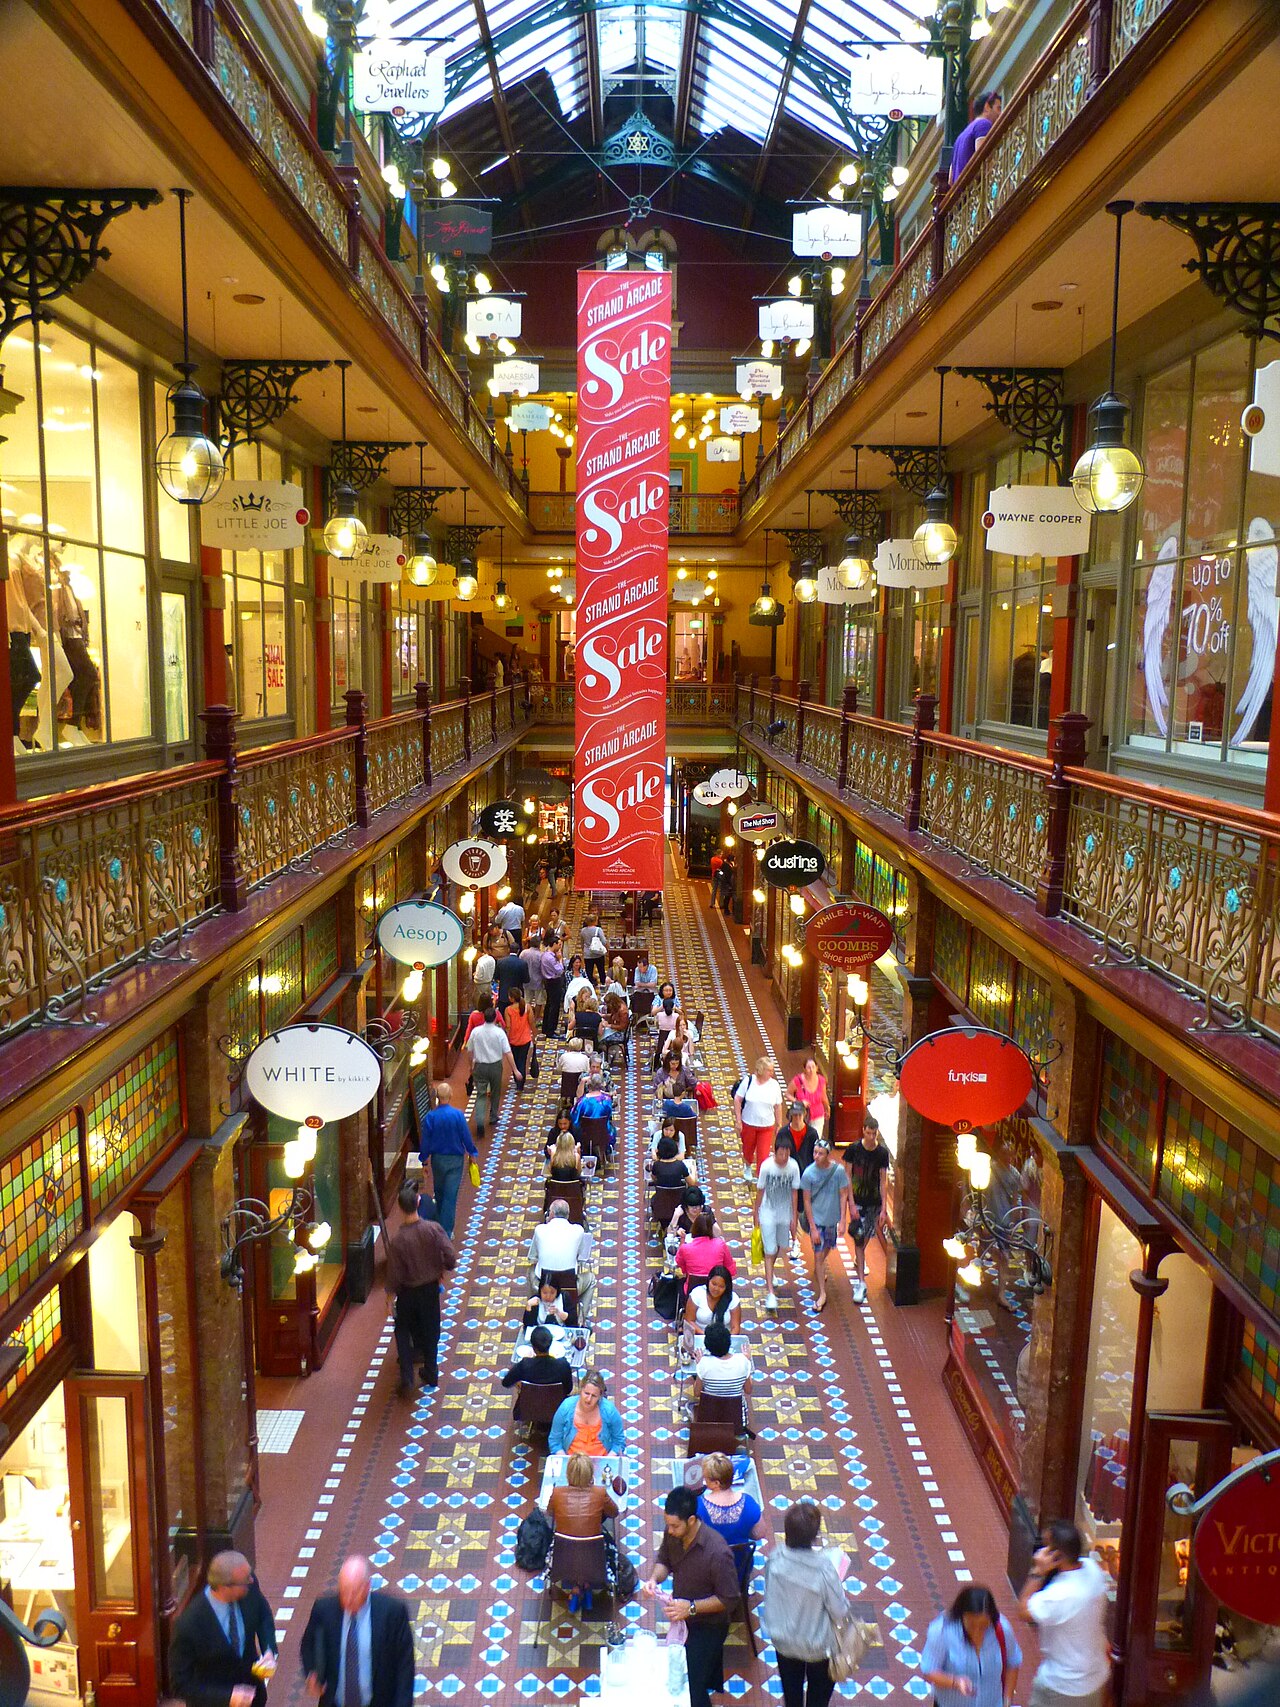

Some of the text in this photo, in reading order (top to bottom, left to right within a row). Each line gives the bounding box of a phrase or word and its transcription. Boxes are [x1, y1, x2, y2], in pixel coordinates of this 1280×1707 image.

[369, 59, 427, 85] Raphael
[365, 82, 430, 104] Jewellers
[620, 281, 630, 291] THE
[587, 276, 663, 327] STRAND ARCADE
[580, 330, 667, 410] Sale
[1249, 415, 1261, 428] 69
[618, 432, 628, 443] THE
[586, 428, 661, 477] STRAND ARCADE
[217, 517, 288, 530] LITTLE JOE
[579, 479, 665, 558] Sale
[998, 513, 1082, 524] WAYNE COOPER
[341, 559, 370, 567] LITTLE
[373, 559, 391, 568] JOE
[1192, 557, 1231, 592] up to
[617, 579, 627, 590] THE
[585, 592, 621, 624] STRAND
[623, 575, 659, 606] ARCADE
[1210, 620, 1230, 654] off
[578, 626, 663, 703] Sale
[267, 667, 284, 688] SALE
[616, 723, 626, 733] THE
[584, 719, 658, 767] STRAND ARCADE
[714, 778, 743, 789] seed
[577, 769, 661, 844] Sale
[743, 820, 753, 828] The
[753, 819, 762, 827] Nut
[768, 855, 818, 869] dustins
[817, 940, 879, 952] COOMBS
[822, 951, 874, 964] SHOE REPAIRS
[262, 1066, 335, 1082] WHITE
[308, 1118, 319, 1127] 22
[958, 1121, 968, 1131] 19
